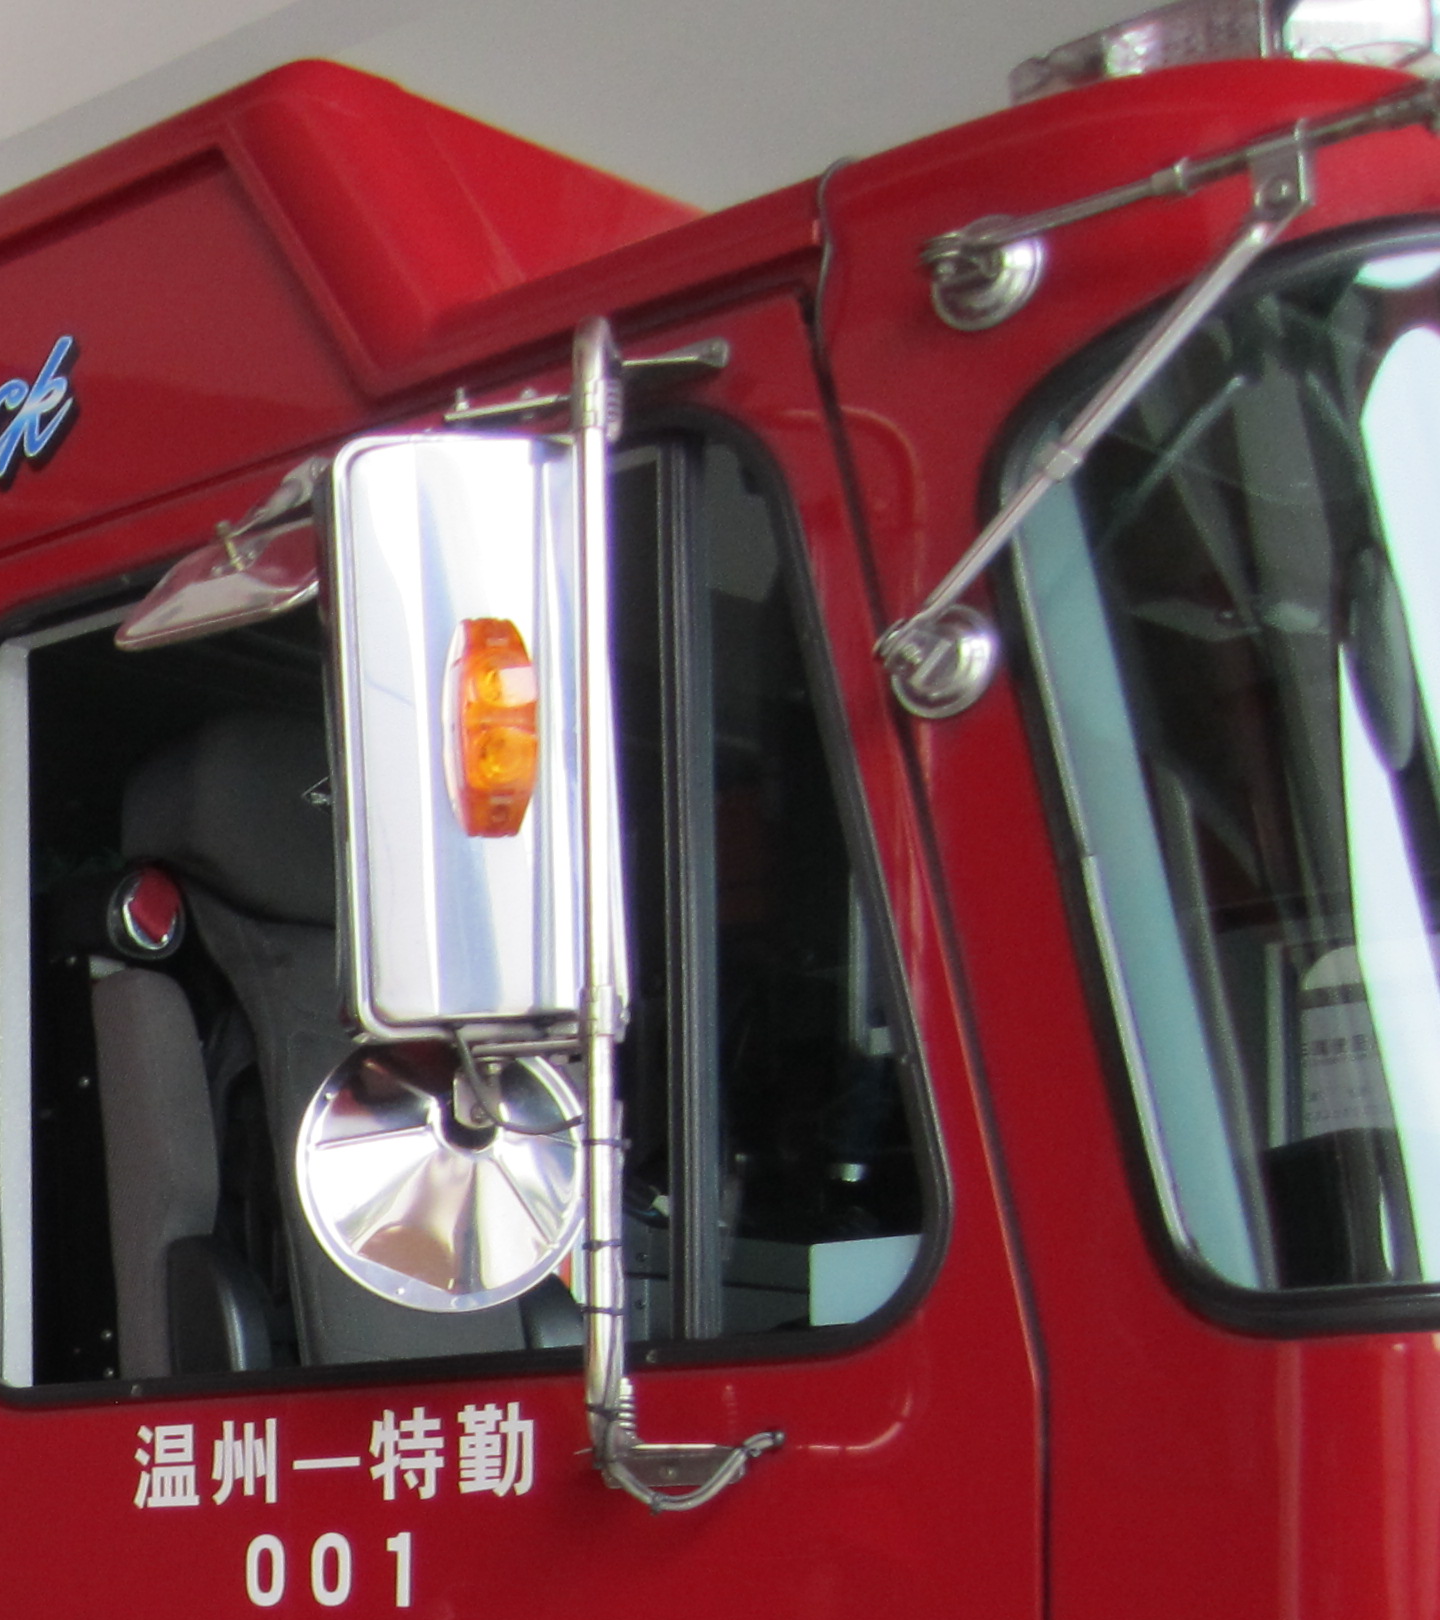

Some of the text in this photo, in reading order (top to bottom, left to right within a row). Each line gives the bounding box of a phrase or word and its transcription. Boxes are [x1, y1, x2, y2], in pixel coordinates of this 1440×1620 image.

[133, 1402, 536, 1510] 温州一特勤
[245, 1531, 415, 1609] 001
